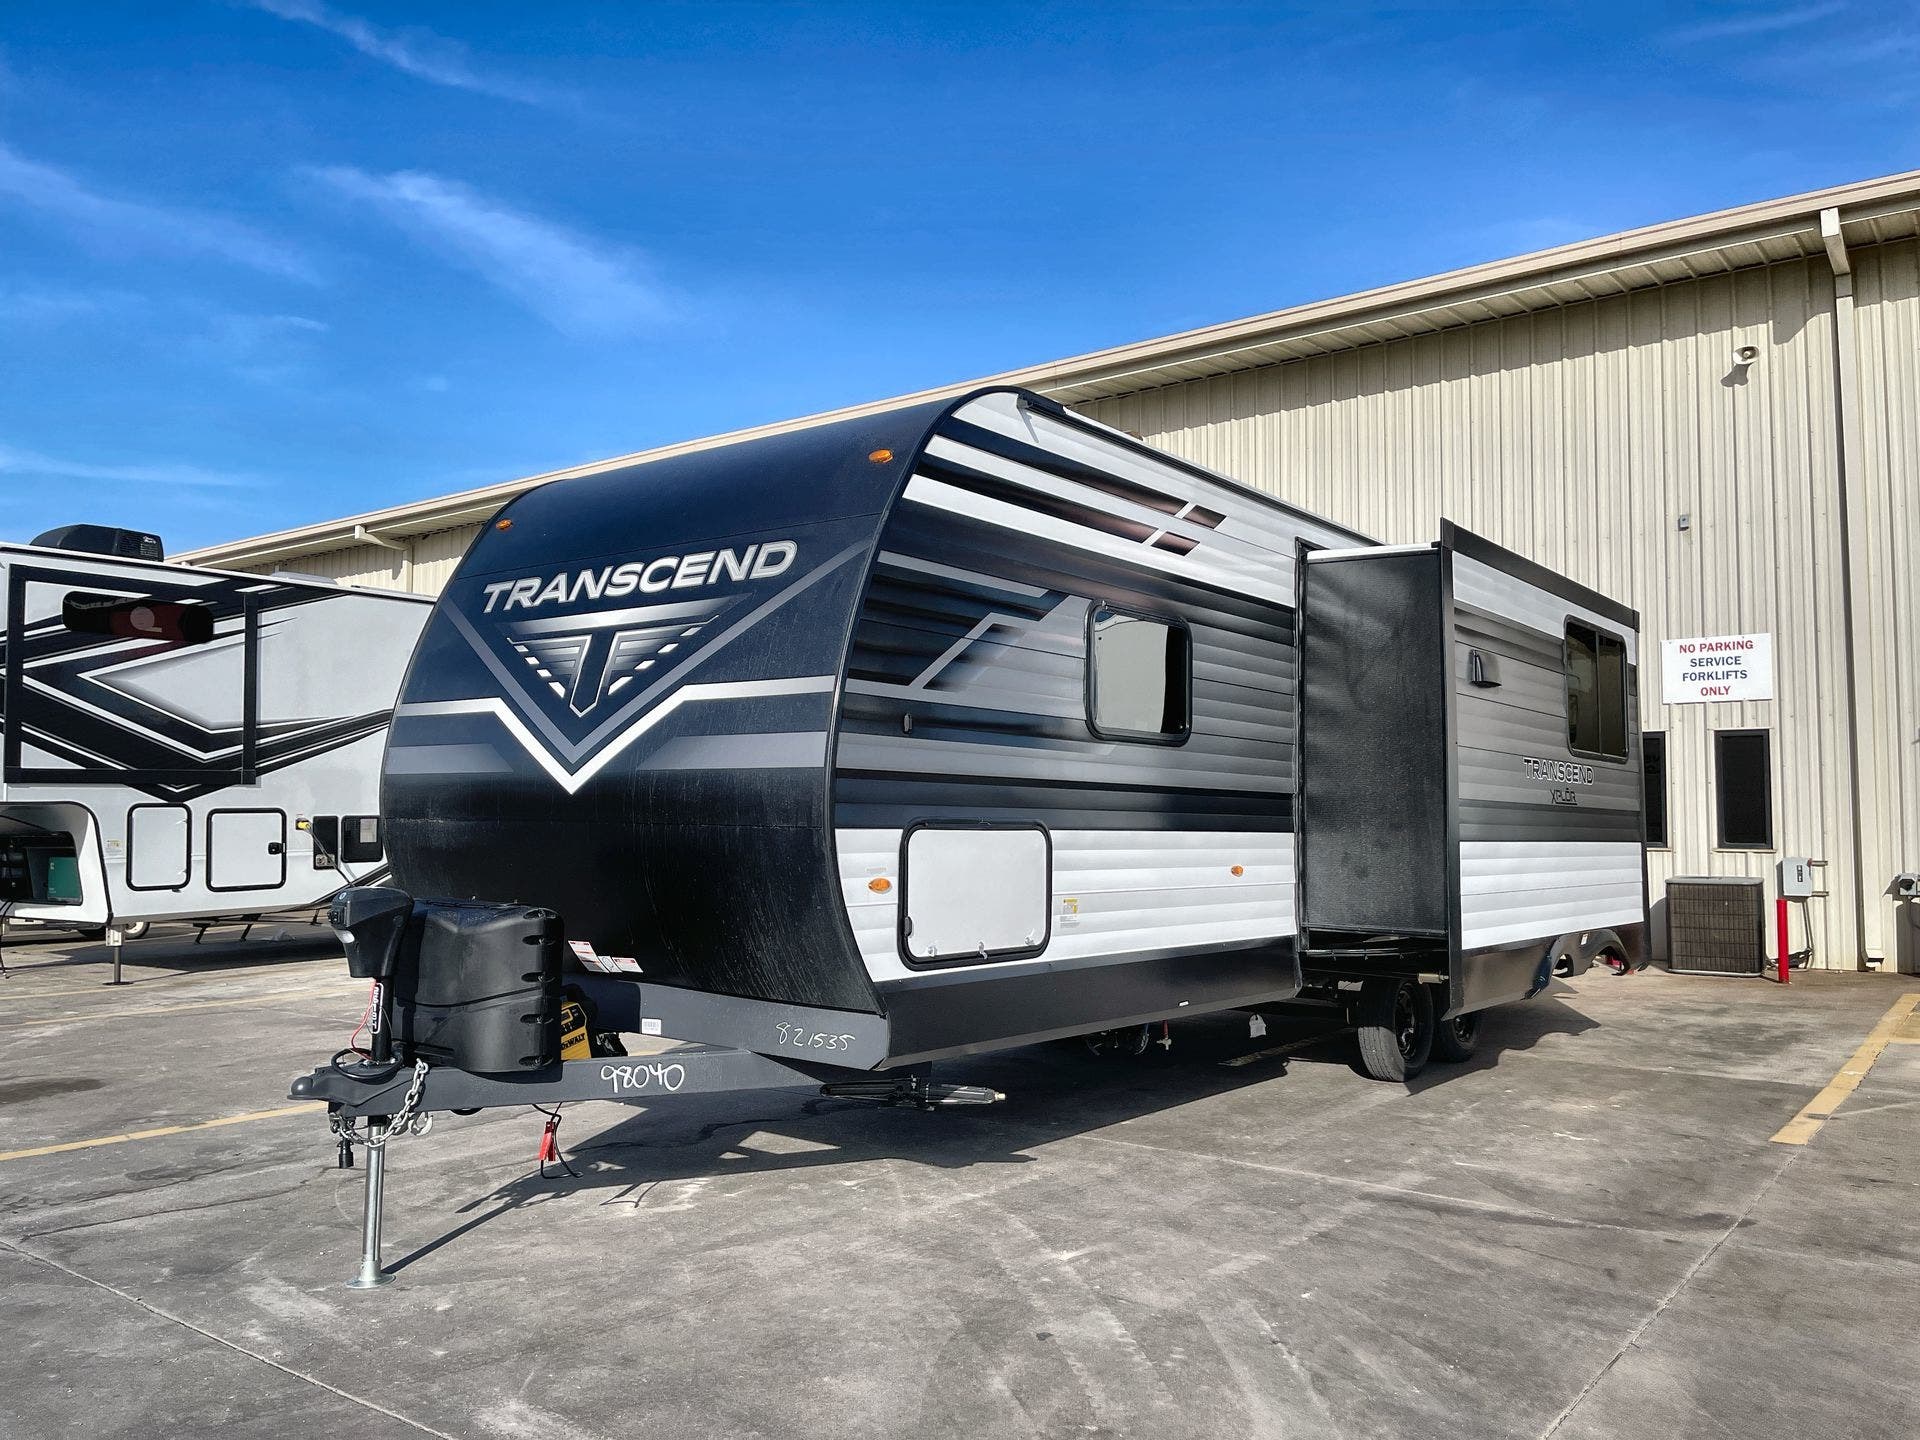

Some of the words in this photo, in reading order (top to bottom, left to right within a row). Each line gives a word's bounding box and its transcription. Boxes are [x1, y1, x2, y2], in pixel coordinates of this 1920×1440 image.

[483, 540, 798, 613] TRANSCEND
[1679, 644, 1696, 653] NO
[1700, 640, 1754, 652] PARKING
[1690, 656, 1742, 667] SERVICE
[1682, 670, 1748, 681] FORKLIFTS
[1700, 686, 1731, 696] ONLY
[1523, 757, 1594, 785] TRANSCEND
[775, 1022, 856, 1051] 821535
[601, 1063, 685, 1093] 98040
